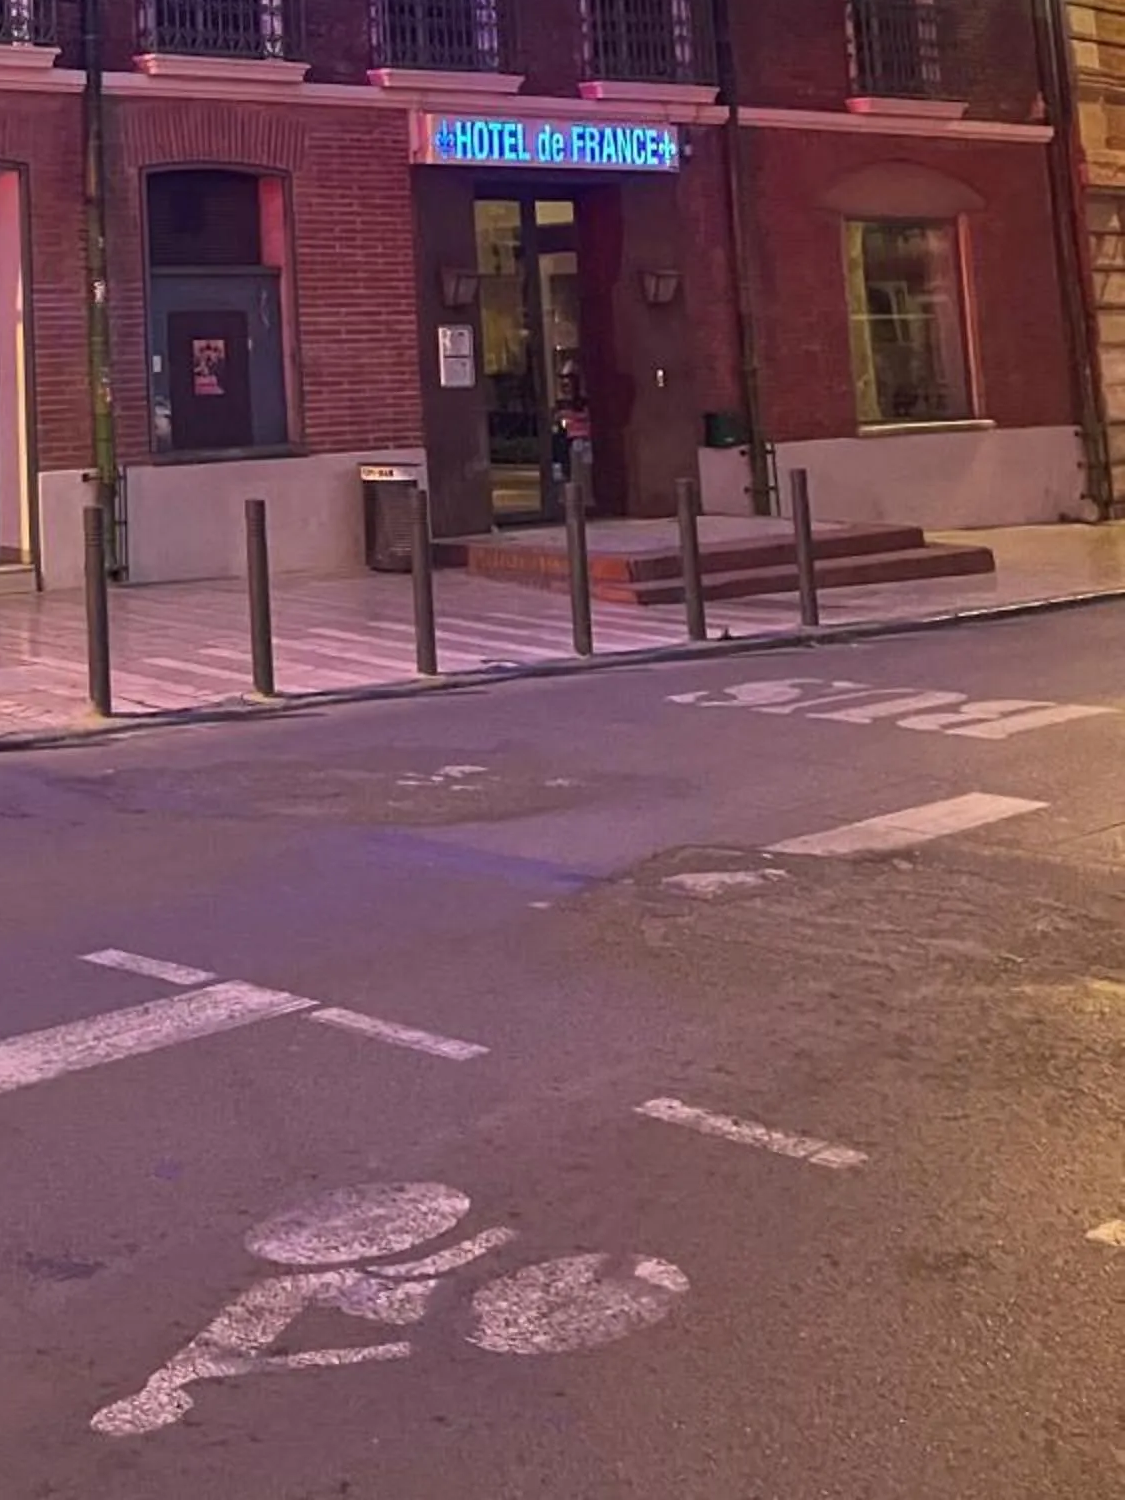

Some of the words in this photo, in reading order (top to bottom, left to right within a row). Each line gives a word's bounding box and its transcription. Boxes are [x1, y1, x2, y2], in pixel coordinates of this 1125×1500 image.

[455, 119, 531, 161] HOTEL
[537, 124, 565, 163] de
[570, 125, 659, 165] FRANCE
